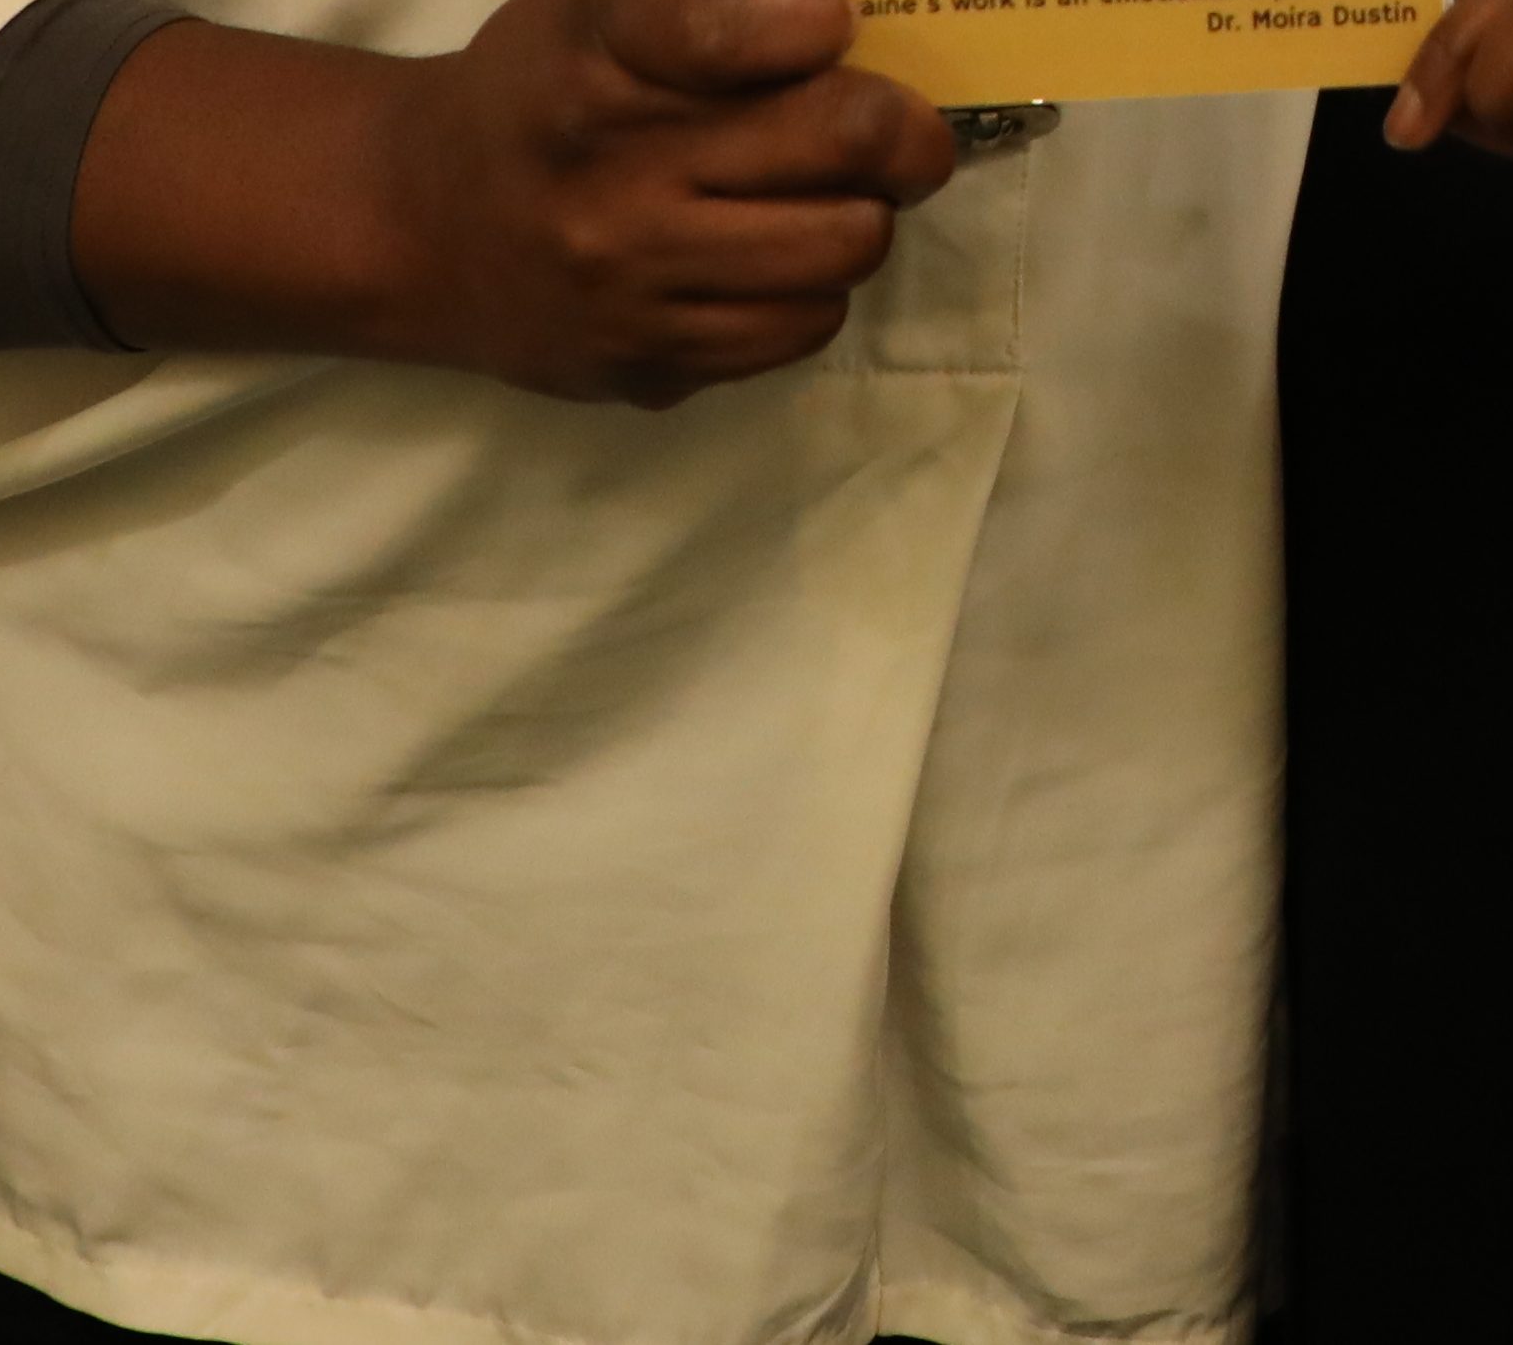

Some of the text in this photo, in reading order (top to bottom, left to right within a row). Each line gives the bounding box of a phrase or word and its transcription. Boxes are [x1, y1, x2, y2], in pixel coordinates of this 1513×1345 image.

[1206, 0, 1417, 33] Dr. Moira Dustin
